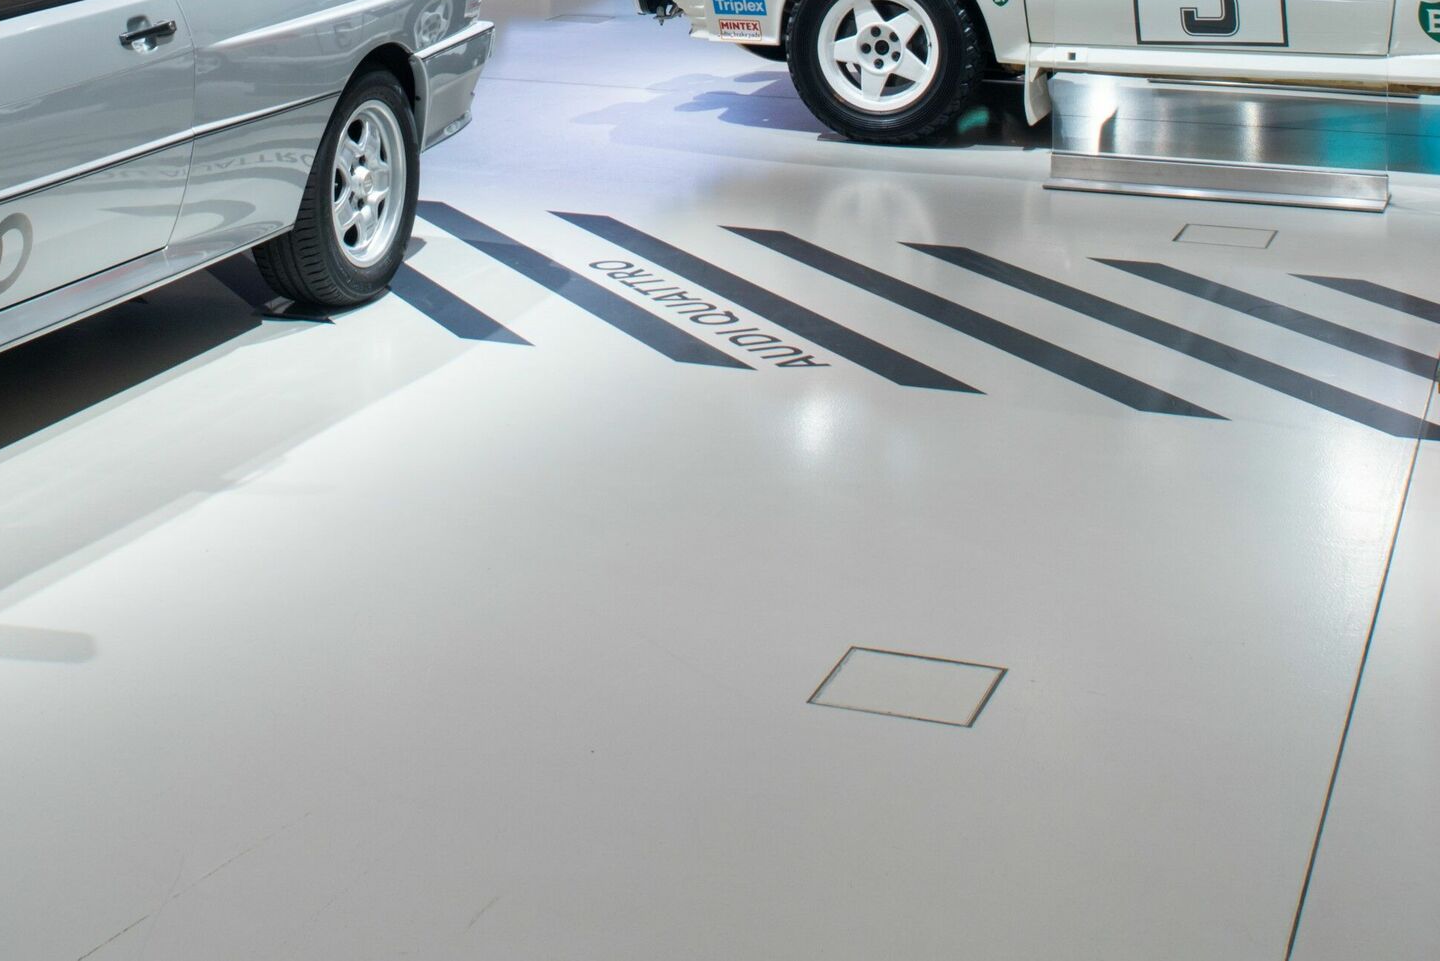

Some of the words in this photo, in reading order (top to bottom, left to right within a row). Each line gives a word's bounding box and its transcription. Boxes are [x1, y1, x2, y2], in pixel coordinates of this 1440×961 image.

[721, 22, 759, 31] MINTEX
[588, 259, 740, 326] QUATTRO
[715, 327, 832, 368] AUDI
